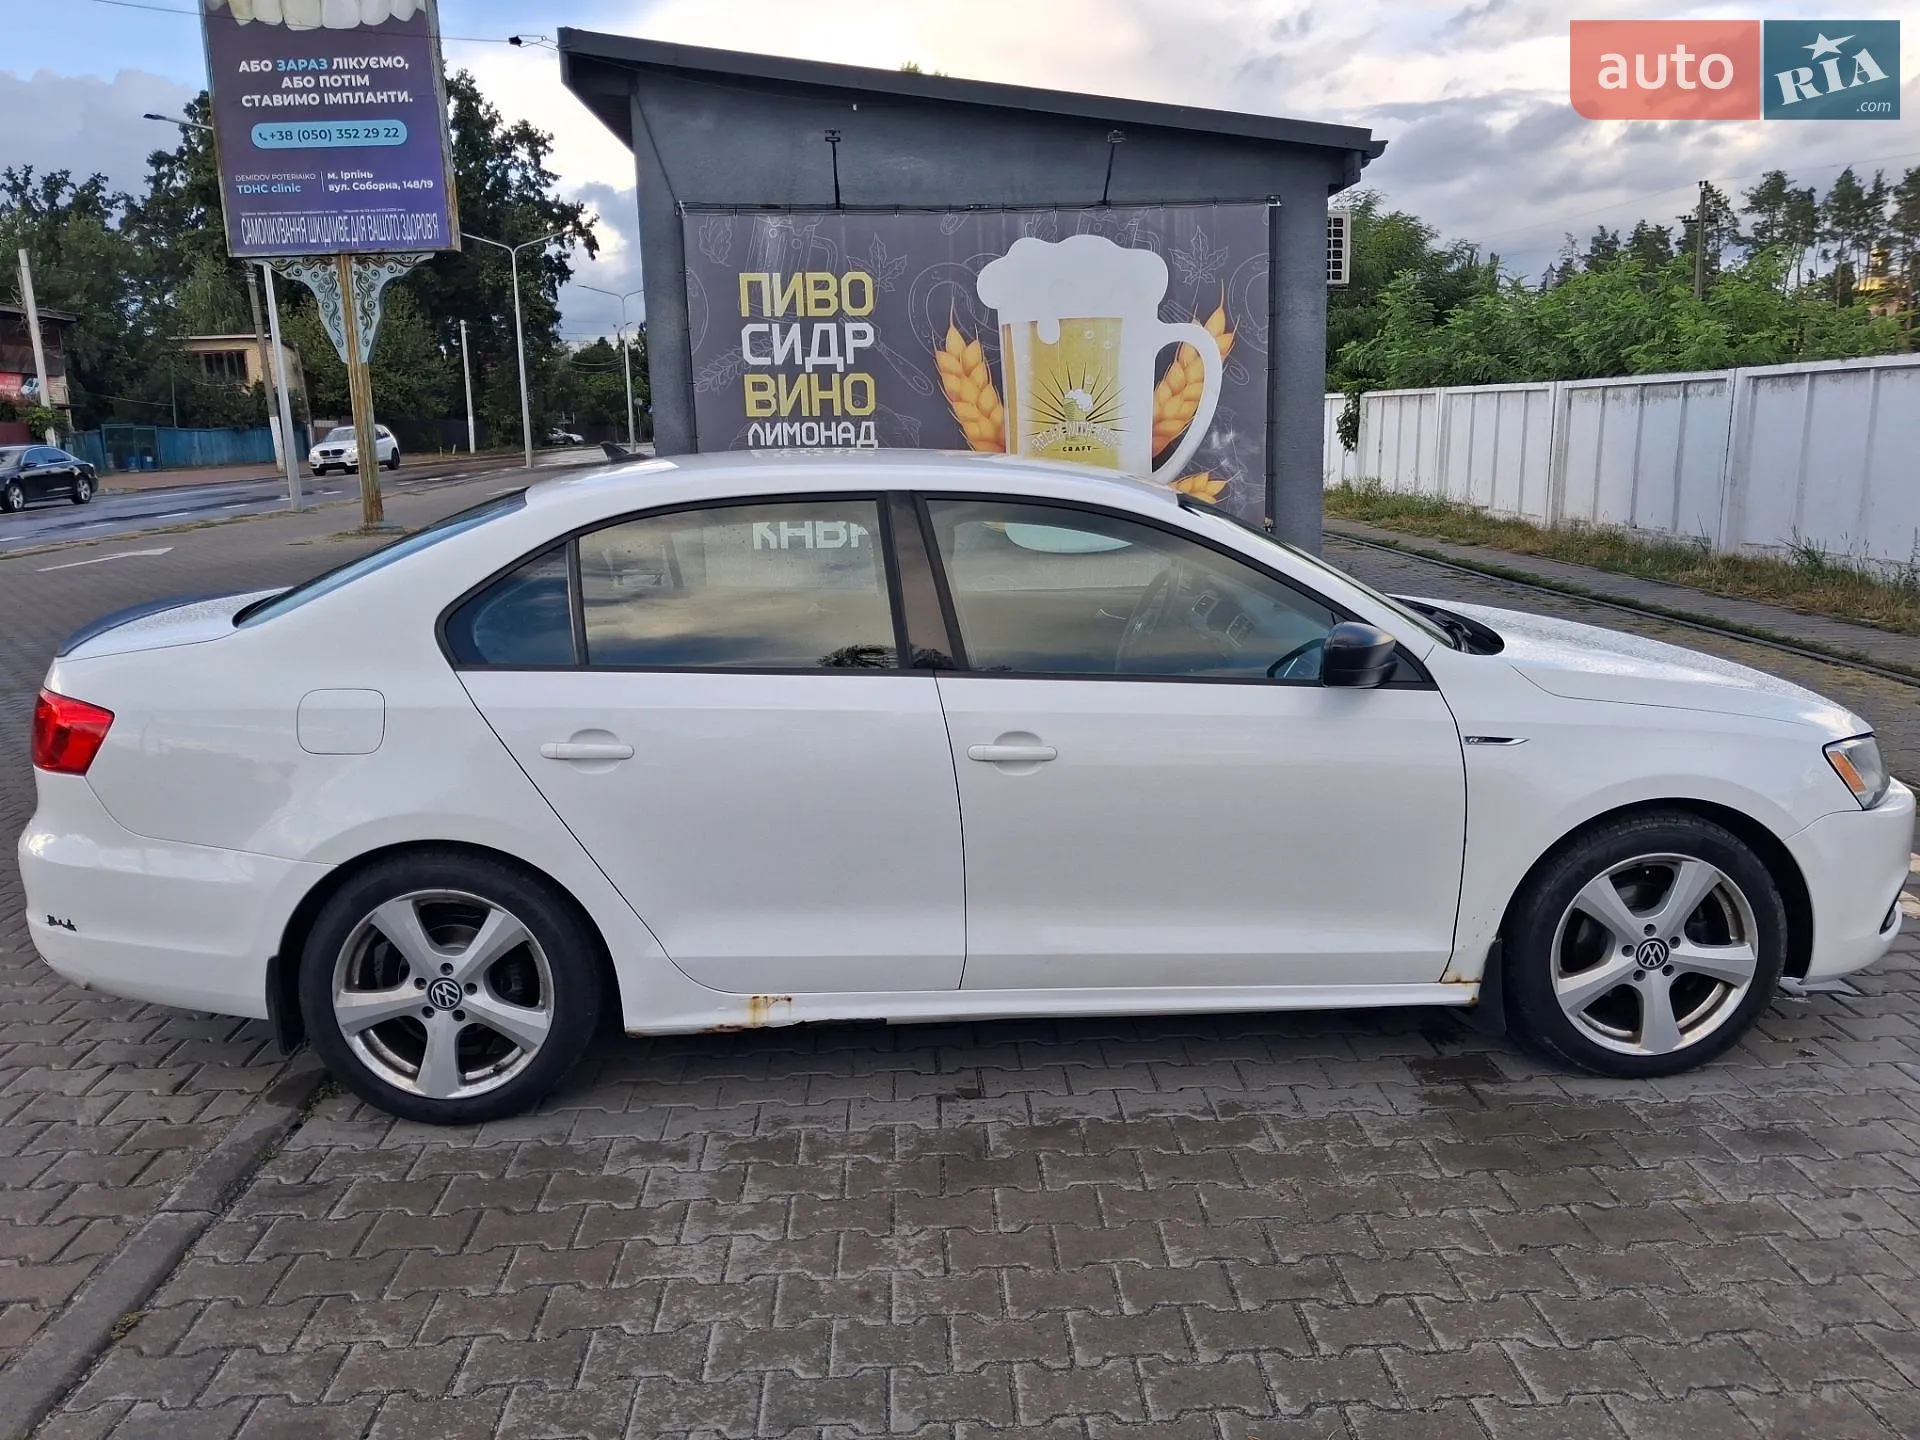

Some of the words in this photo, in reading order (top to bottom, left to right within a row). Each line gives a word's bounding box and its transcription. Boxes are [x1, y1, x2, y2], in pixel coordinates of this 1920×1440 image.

[238, 59, 273, 73] АБО
[276, 58, 329, 72] ЗАРАЗ
[331, 56, 410, 70] ЛІКУЄМО,
[281, 75, 315, 89] АБО
[319, 74, 370, 88] ПОТІМ
[241, 94, 320, 108] СТАВИМО
[324, 90, 413, 106] ІМПЛАНТИ.
[269, 130, 293, 141] +38
[297, 129, 332, 143] (050)
[336, 128, 360, 140] 352
[363, 127, 380, 139] 29
[383, 127, 400, 138] 22
[235, 174, 270, 182] DEMIDOV
[327, 172, 338, 180] м.
[340, 169, 374, 180] Ірпінь
[236, 184, 269, 194] TDHC
[271, 183, 302, 193] clinic
[328, 183, 350, 193] вул.
[352, 181, 401, 192] Соборна,
[402, 179, 434, 190] 148/19
[350, 215, 367, 247] ДЛЯ
[367, 214, 400, 242] ВАШОГО
[739, 271, 875, 318] ПИВО
[741, 322, 875, 373] СИДР
[743, 372, 876, 417] ВИНО
[747, 421, 879, 449] ЛИМОНАД
